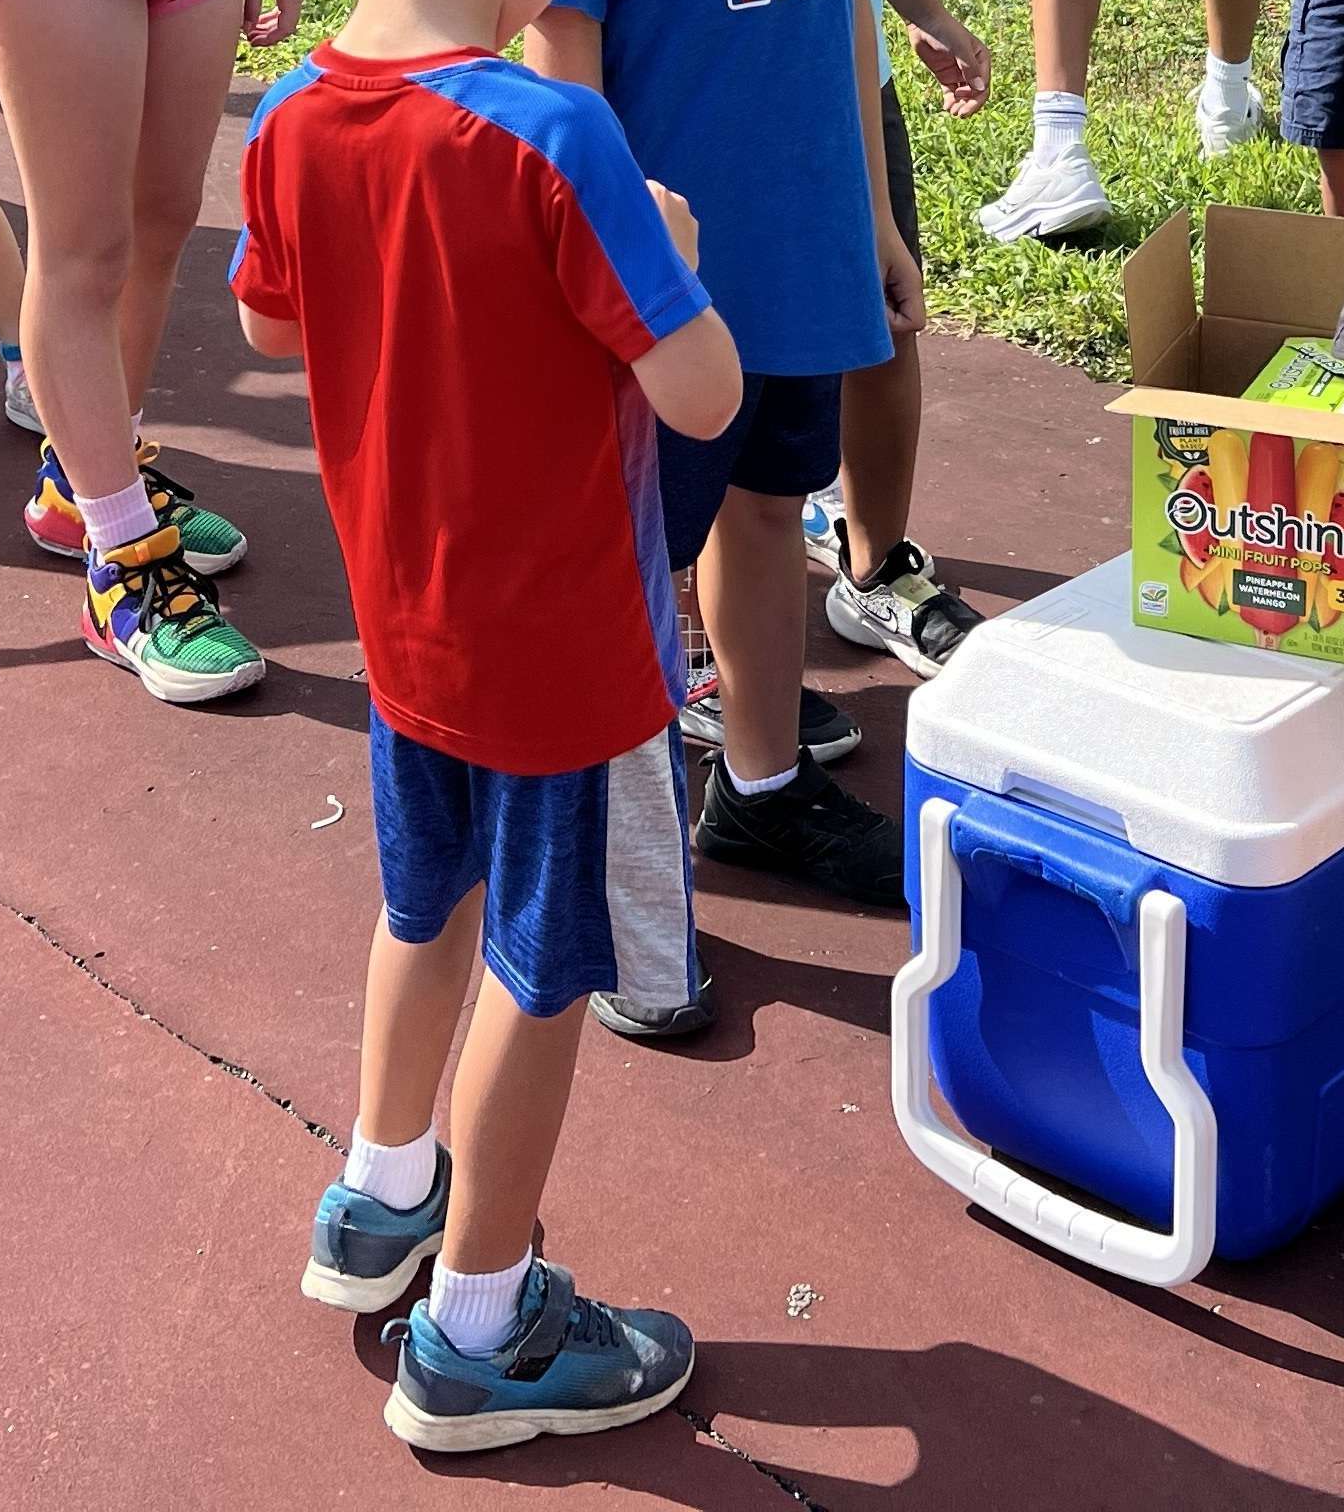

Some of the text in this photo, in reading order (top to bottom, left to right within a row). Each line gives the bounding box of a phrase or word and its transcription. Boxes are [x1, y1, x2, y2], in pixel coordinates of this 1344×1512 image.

[1207, 543, 1332, 576] MINI FRUIT POPS
[1245, 575, 1294, 591] PINEAPPLE
[1238, 583, 1301, 602] WATERMELON
[1251, 595, 1287, 609] MANGO
